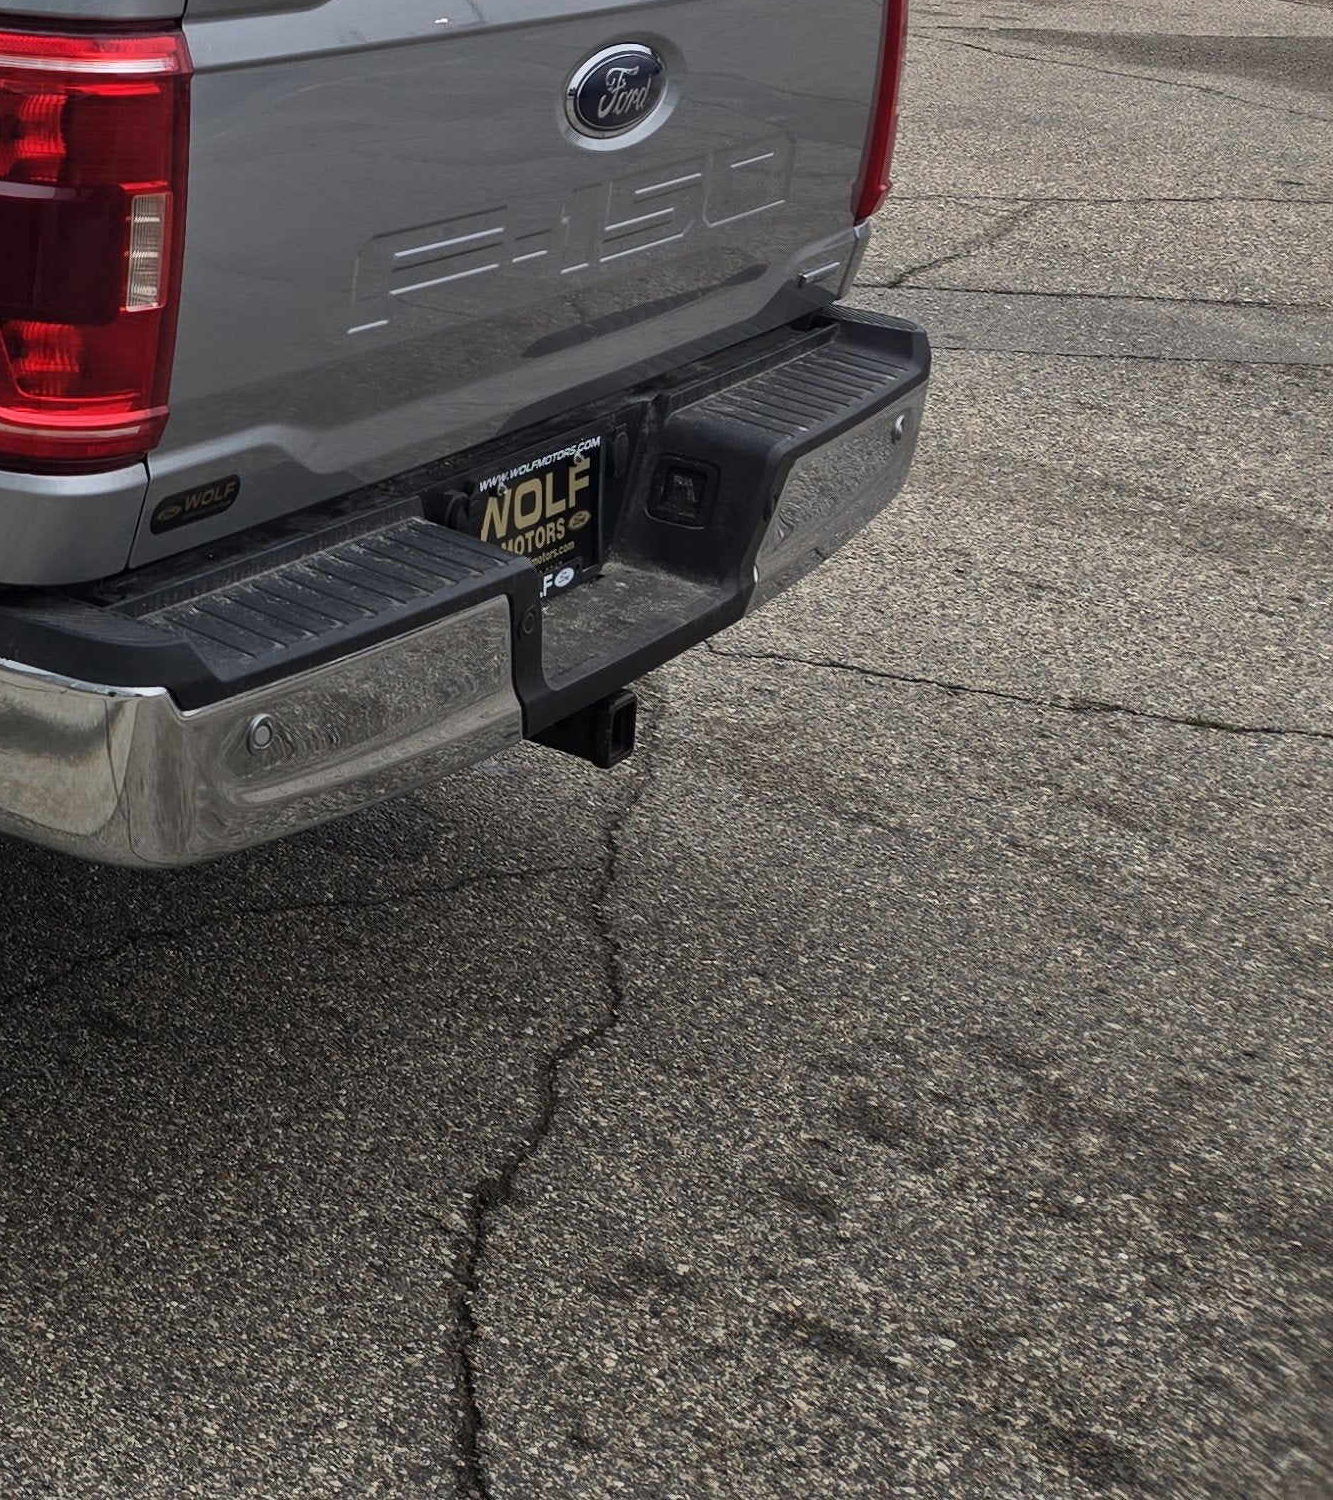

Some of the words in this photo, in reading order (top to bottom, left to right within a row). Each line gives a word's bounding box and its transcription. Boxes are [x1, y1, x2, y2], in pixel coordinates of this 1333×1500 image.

[597, 65, 652, 119] Ford
[347, 132, 797, 334] F-150
[479, 436, 602, 493] WWW.WOLFMOTORS.COM
[185, 481, 237, 512] WOLF
[480, 457, 591, 543] WOLF
